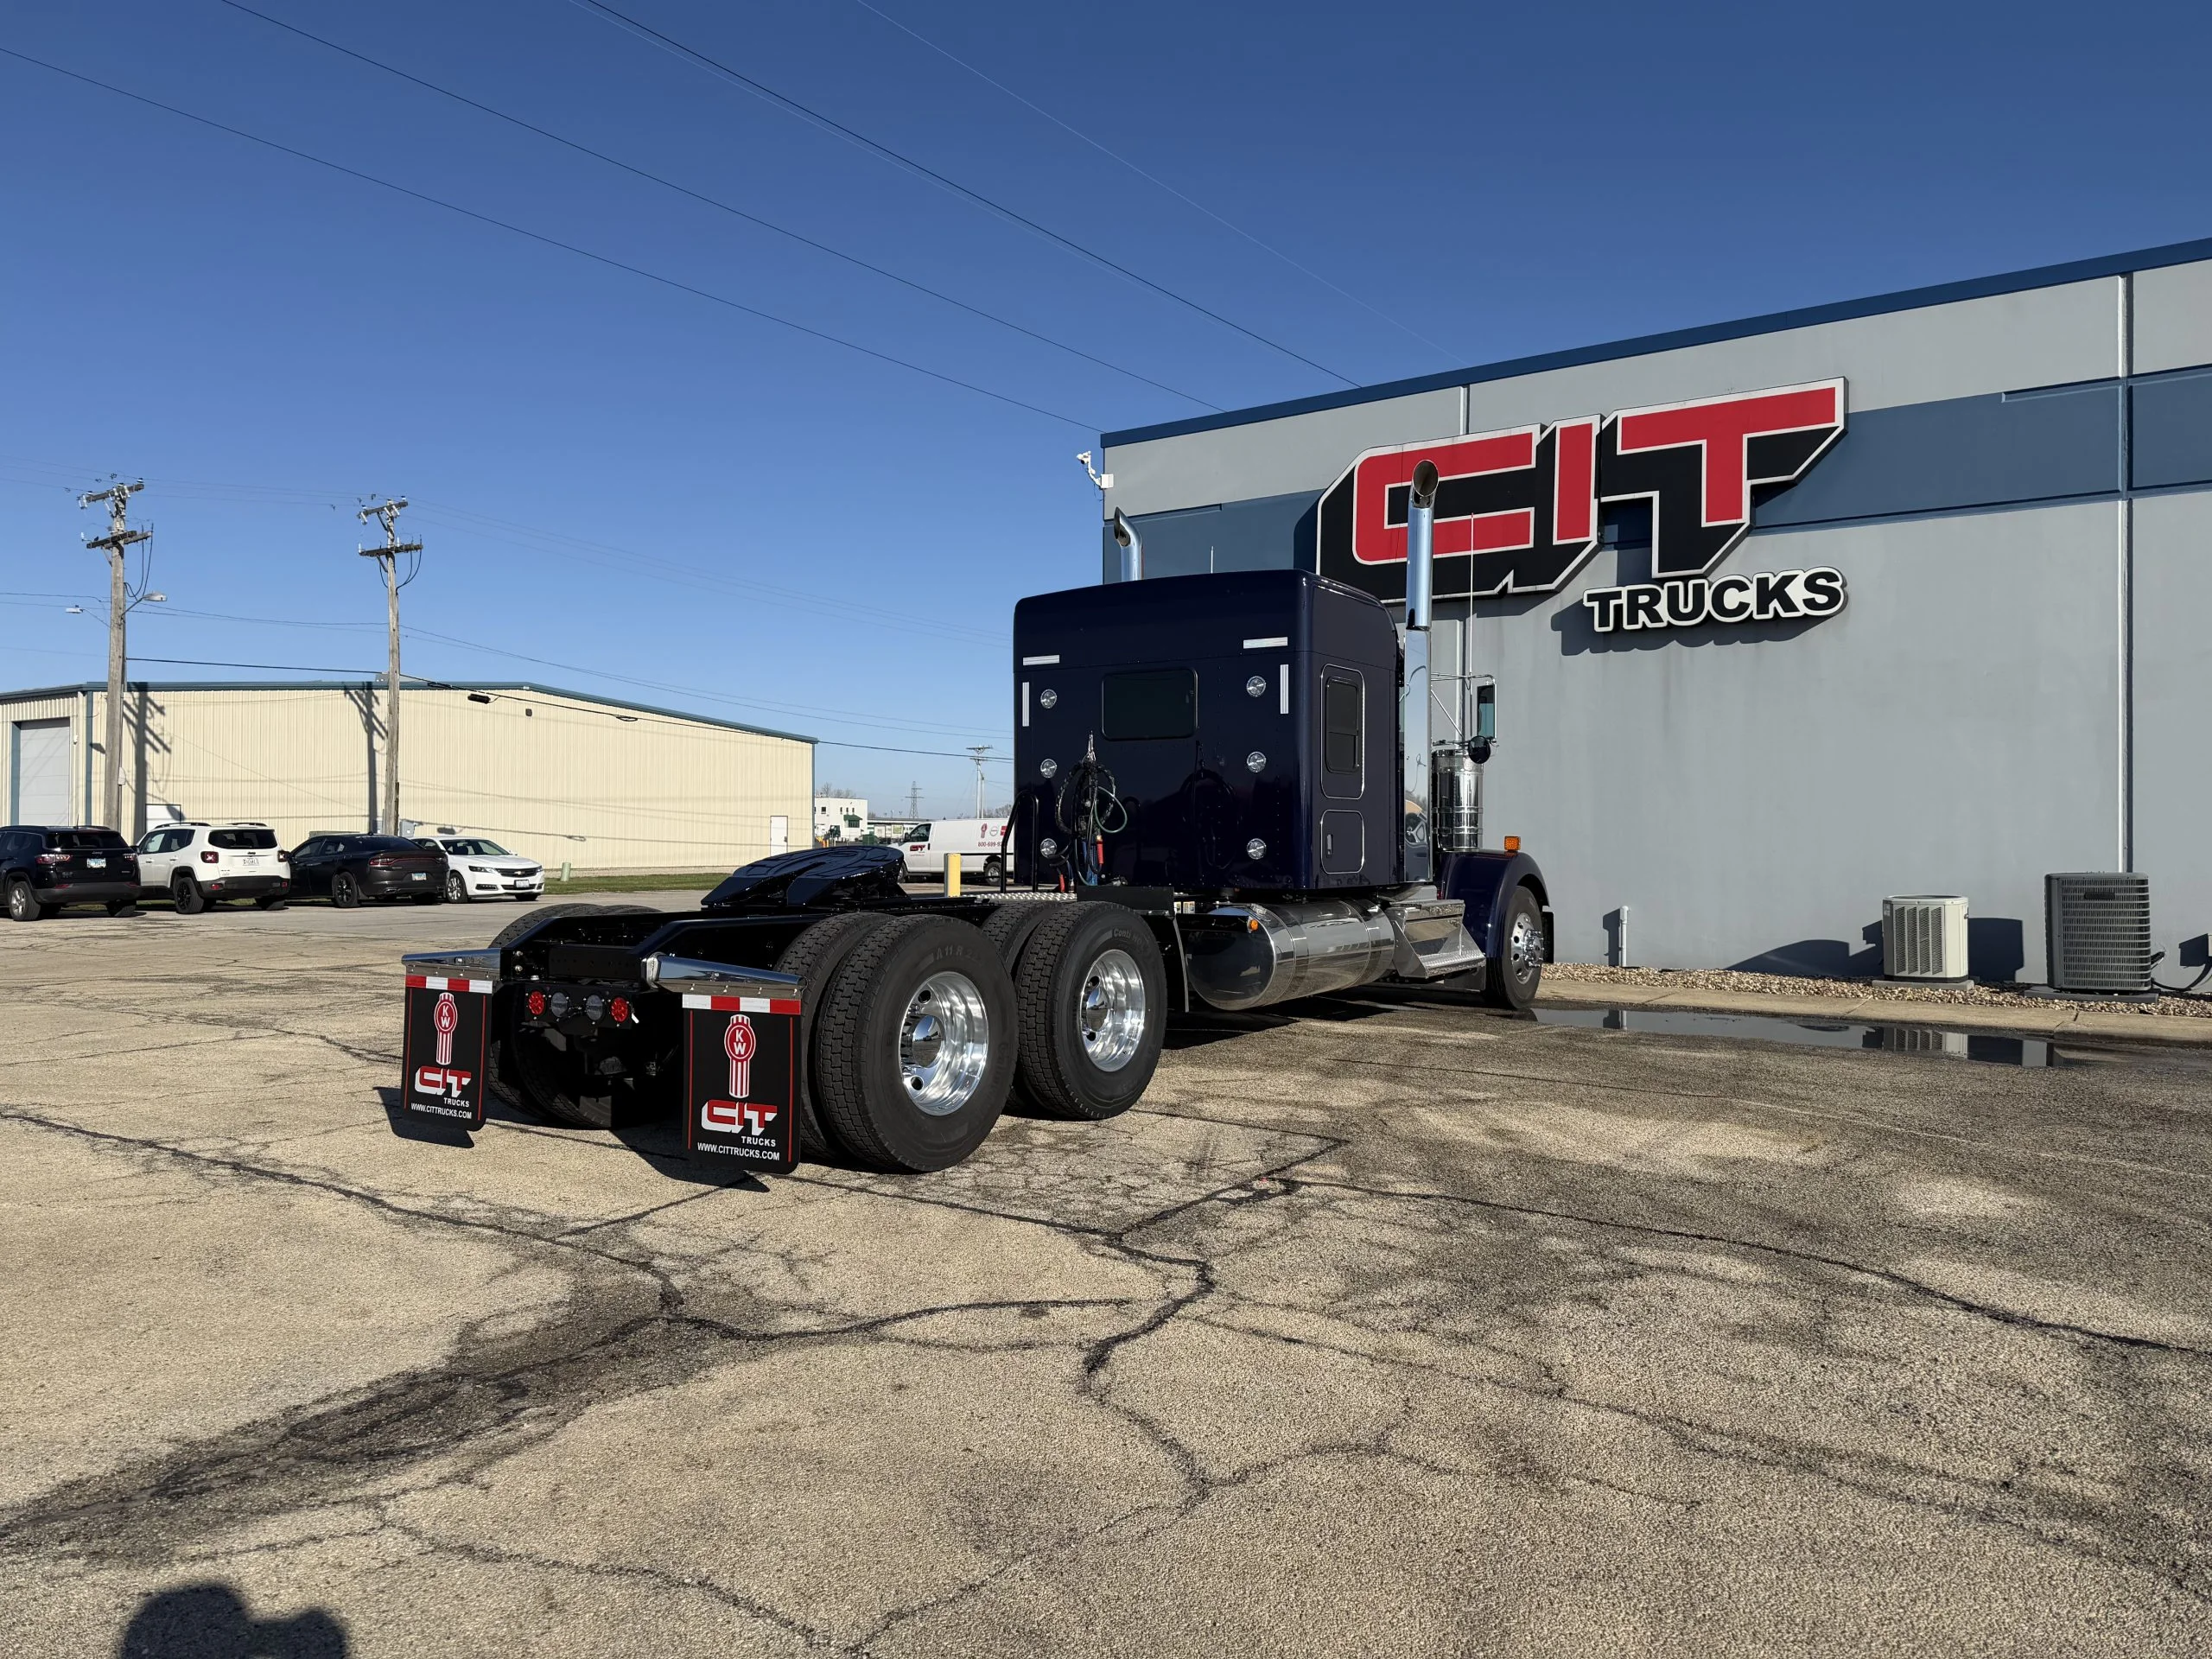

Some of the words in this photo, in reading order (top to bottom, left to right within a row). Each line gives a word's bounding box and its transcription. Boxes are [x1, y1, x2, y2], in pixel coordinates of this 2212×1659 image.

[1332, 378, 1845, 588] CIT
[1585, 567, 1846, 632] TRUCKS
[442, 1005, 449, 1017] K
[441, 1016, 451, 1028] W
[735, 1029, 744, 1043] K
[734, 1042, 747, 1055] W
[415, 1065, 472, 1097] CIT
[443, 1097, 470, 1108] TRUCKS
[410, 1103, 473, 1120] WWW.CITTRUCKS.COM
[701, 1099, 778, 1136] CIT
[741, 1135, 776, 1147] TRUCKS
[697, 1141, 780, 1160] WWW.CITTRUCKS.COM
